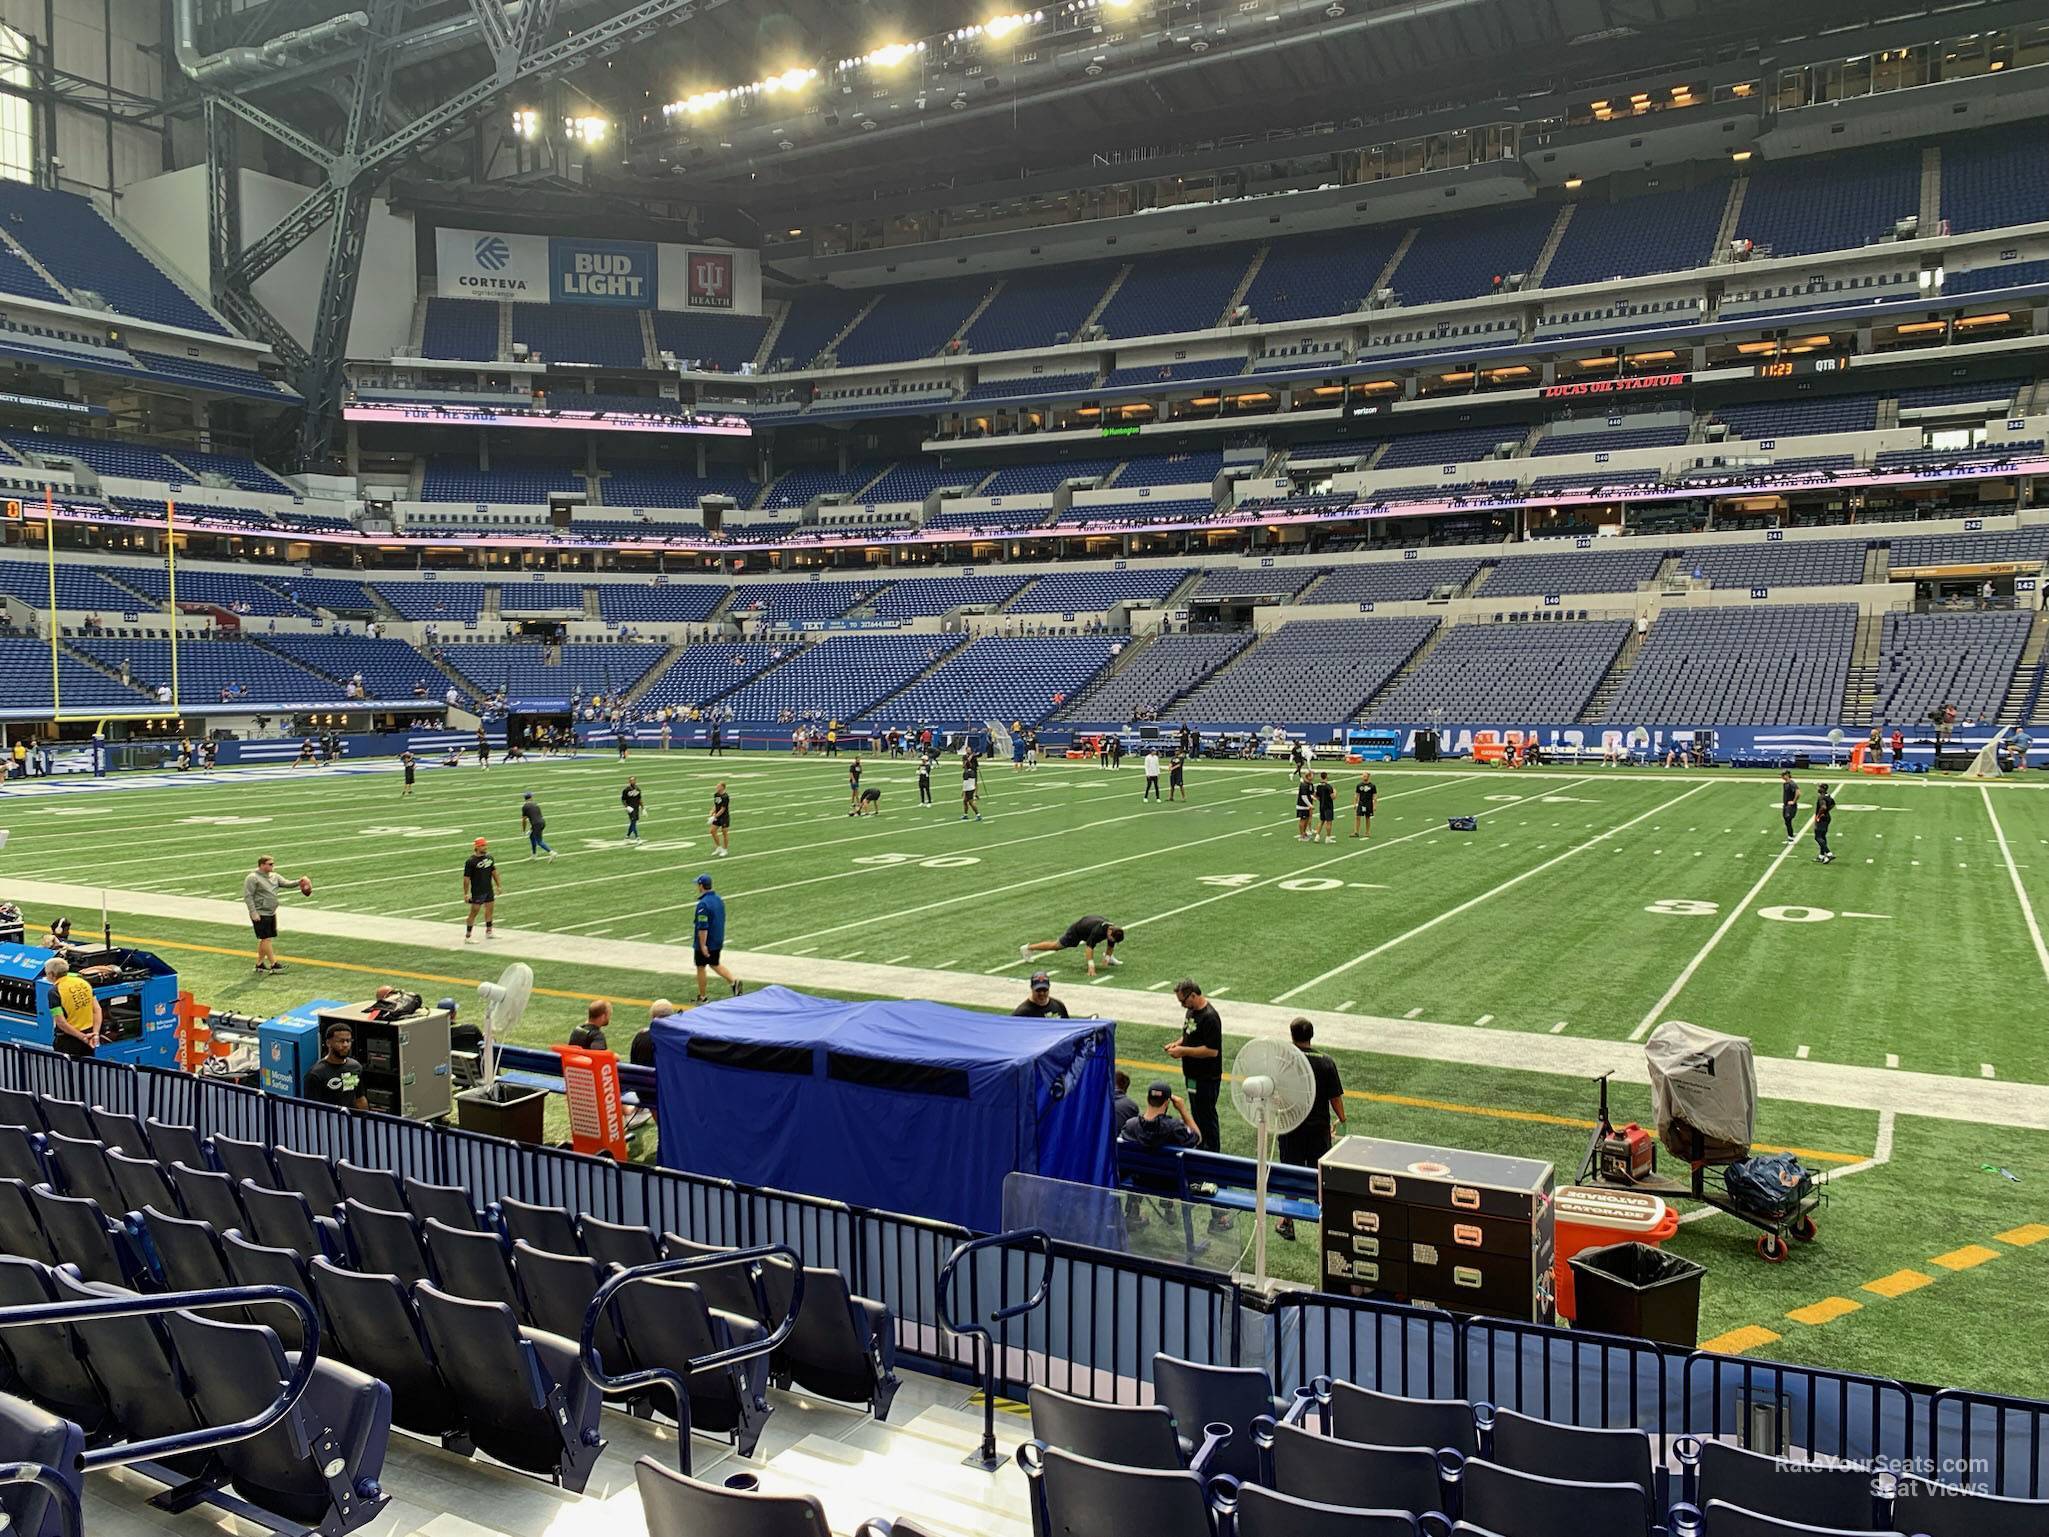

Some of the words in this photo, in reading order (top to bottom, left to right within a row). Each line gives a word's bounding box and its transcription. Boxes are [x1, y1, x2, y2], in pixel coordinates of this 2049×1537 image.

[575, 253, 631, 275] BUD
[459, 275, 528, 290] CORTEVA
[564, 273, 643, 297] LIGHT
[690, 296, 731, 306] HEALTH
[1761, 363, 1793, 377] 11:23
[1815, 358, 1836, 372] QTR
[1839, 357, 1846, 370] 1
[1545, 383, 1588, 397] LUCAS
[1590, 379, 1614, 392] OIL
[1616, 373, 1684, 390] STADIUM
[1353, 407, 1377, 416] verizon
[1608, 417, 1621, 427] 440
[1109, 427, 1140, 436] Huntington
[1767, 531, 1782, 540] 241
[2016, 579, 2036, 591] 142
[1751, 587, 1767, 598] 141
[1545, 595, 1560, 605] 140
[1360, 602, 1374, 613] 139
[801, 621, 825, 630] TEXT
[271, 1070, 294, 1083] Microsoft
[271, 1079, 289, 1091] Surface
[601, 1063, 620, 1144] GATORADE
